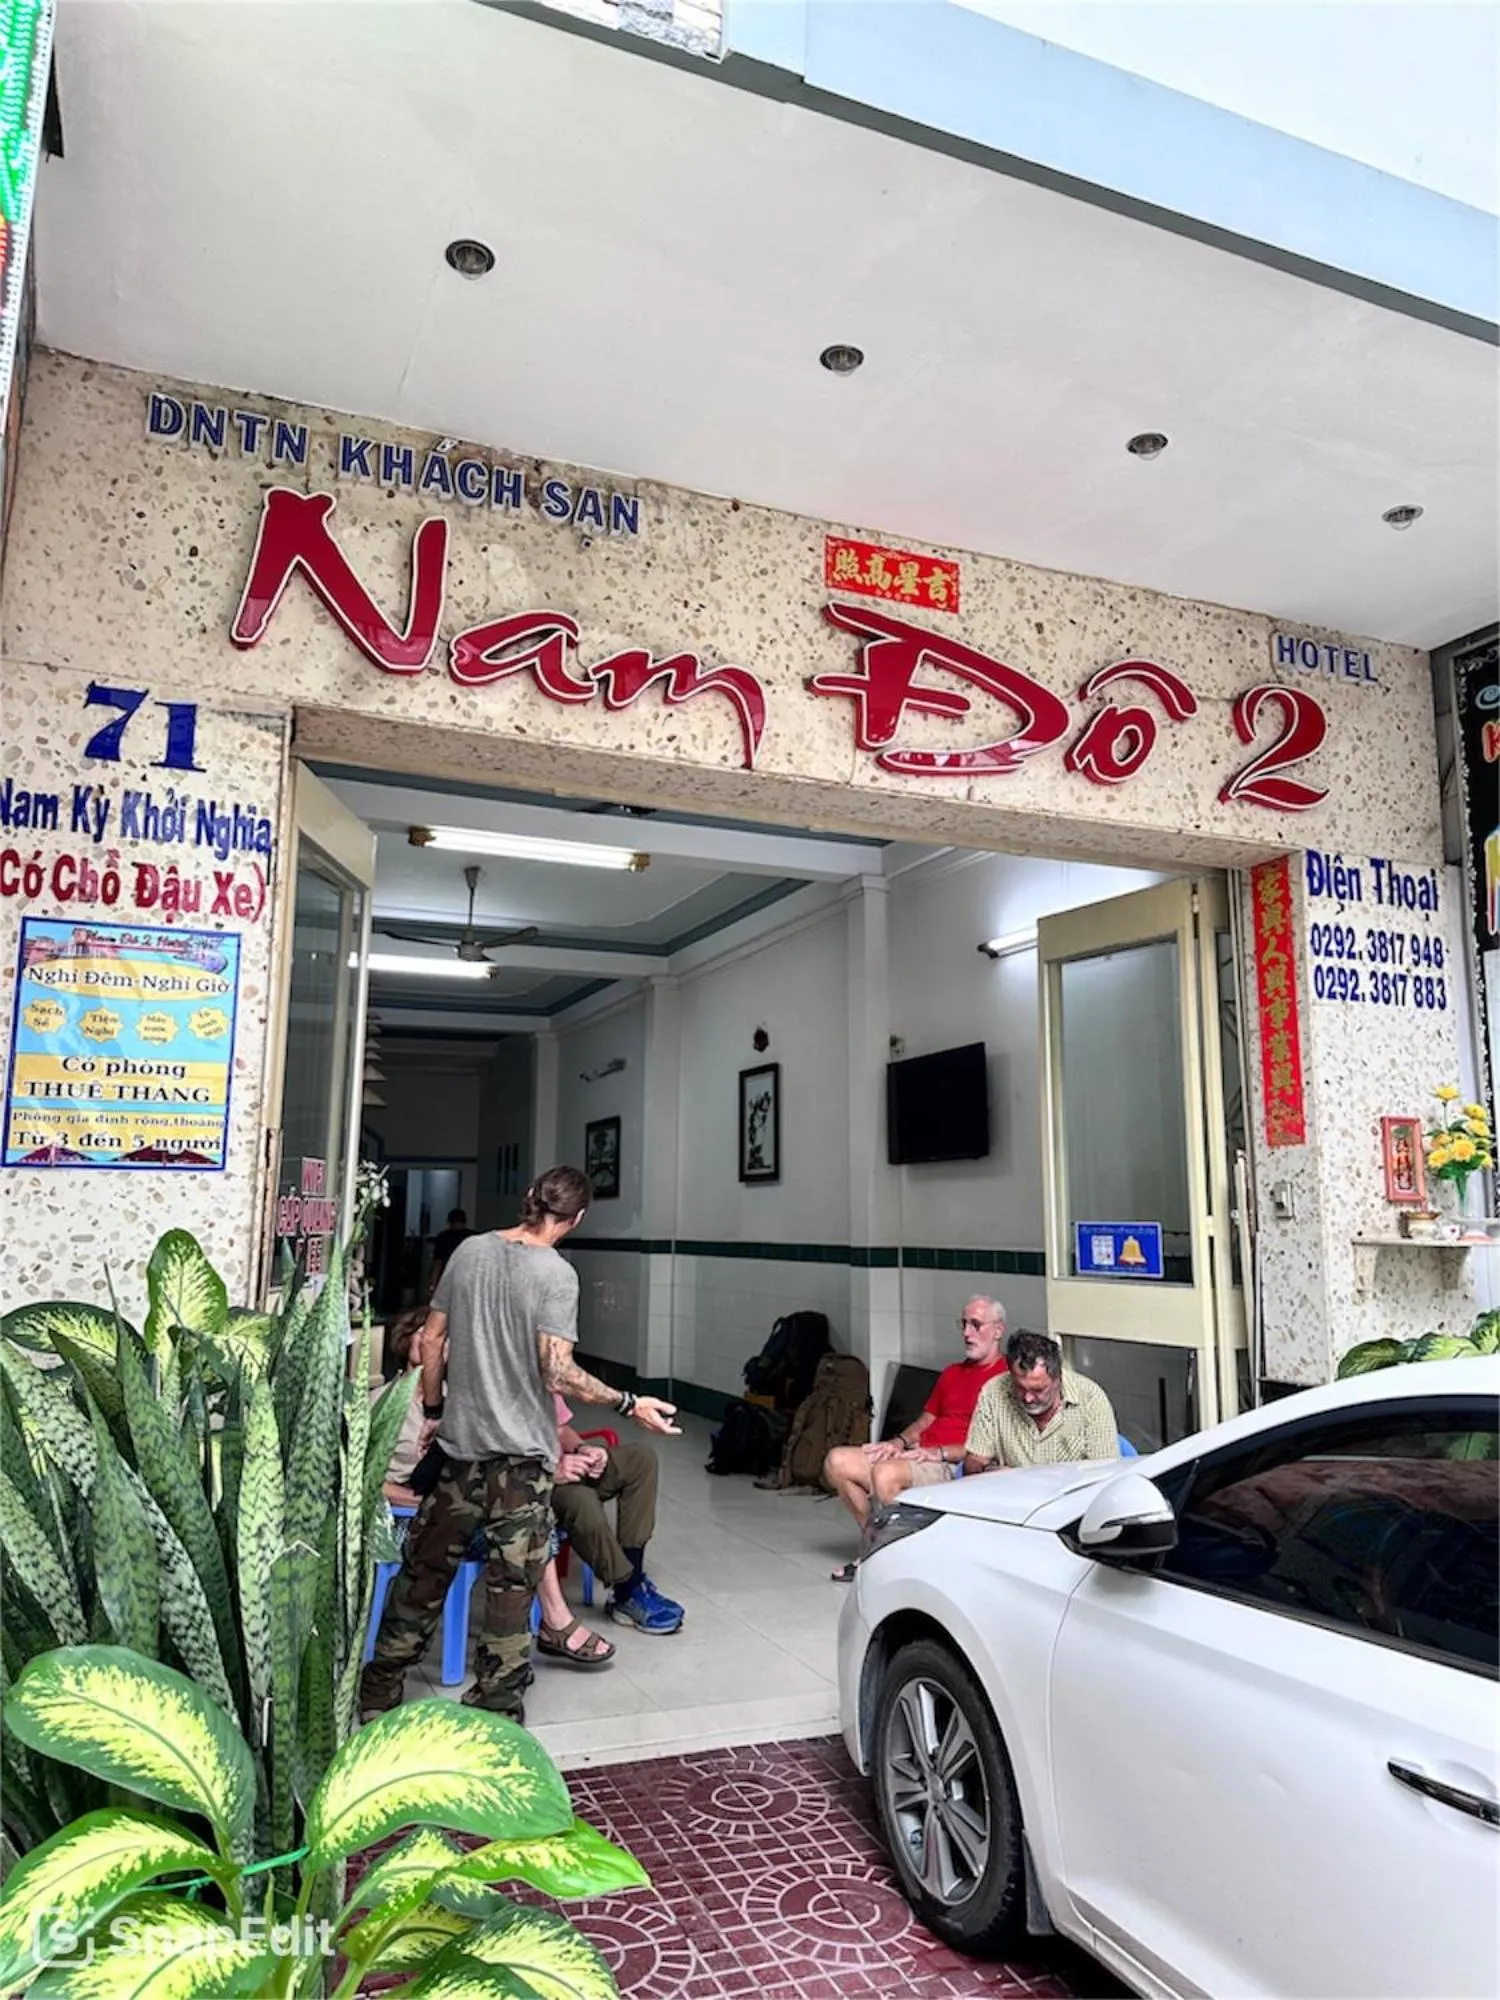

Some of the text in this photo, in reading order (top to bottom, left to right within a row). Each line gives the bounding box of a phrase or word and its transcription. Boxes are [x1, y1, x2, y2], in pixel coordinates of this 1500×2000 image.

[149, 393, 641, 549] DNTN KHÁCH SẠN
[230, 487, 1331, 812] Nam Đô 2
[1276, 633, 1380, 684] HOTEL
[84, 680, 207, 774] 71
[120, 786, 187, 843] Khởi
[1369, 857, 1439, 922] Thoại
[1411, 933, 1445, 969] 948
[1413, 974, 1447, 1011] 883
[62, 1055, 96, 1073] Có
[58, 1131, 69, 1145] 3
[132, 1134, 146, 1148] 5
